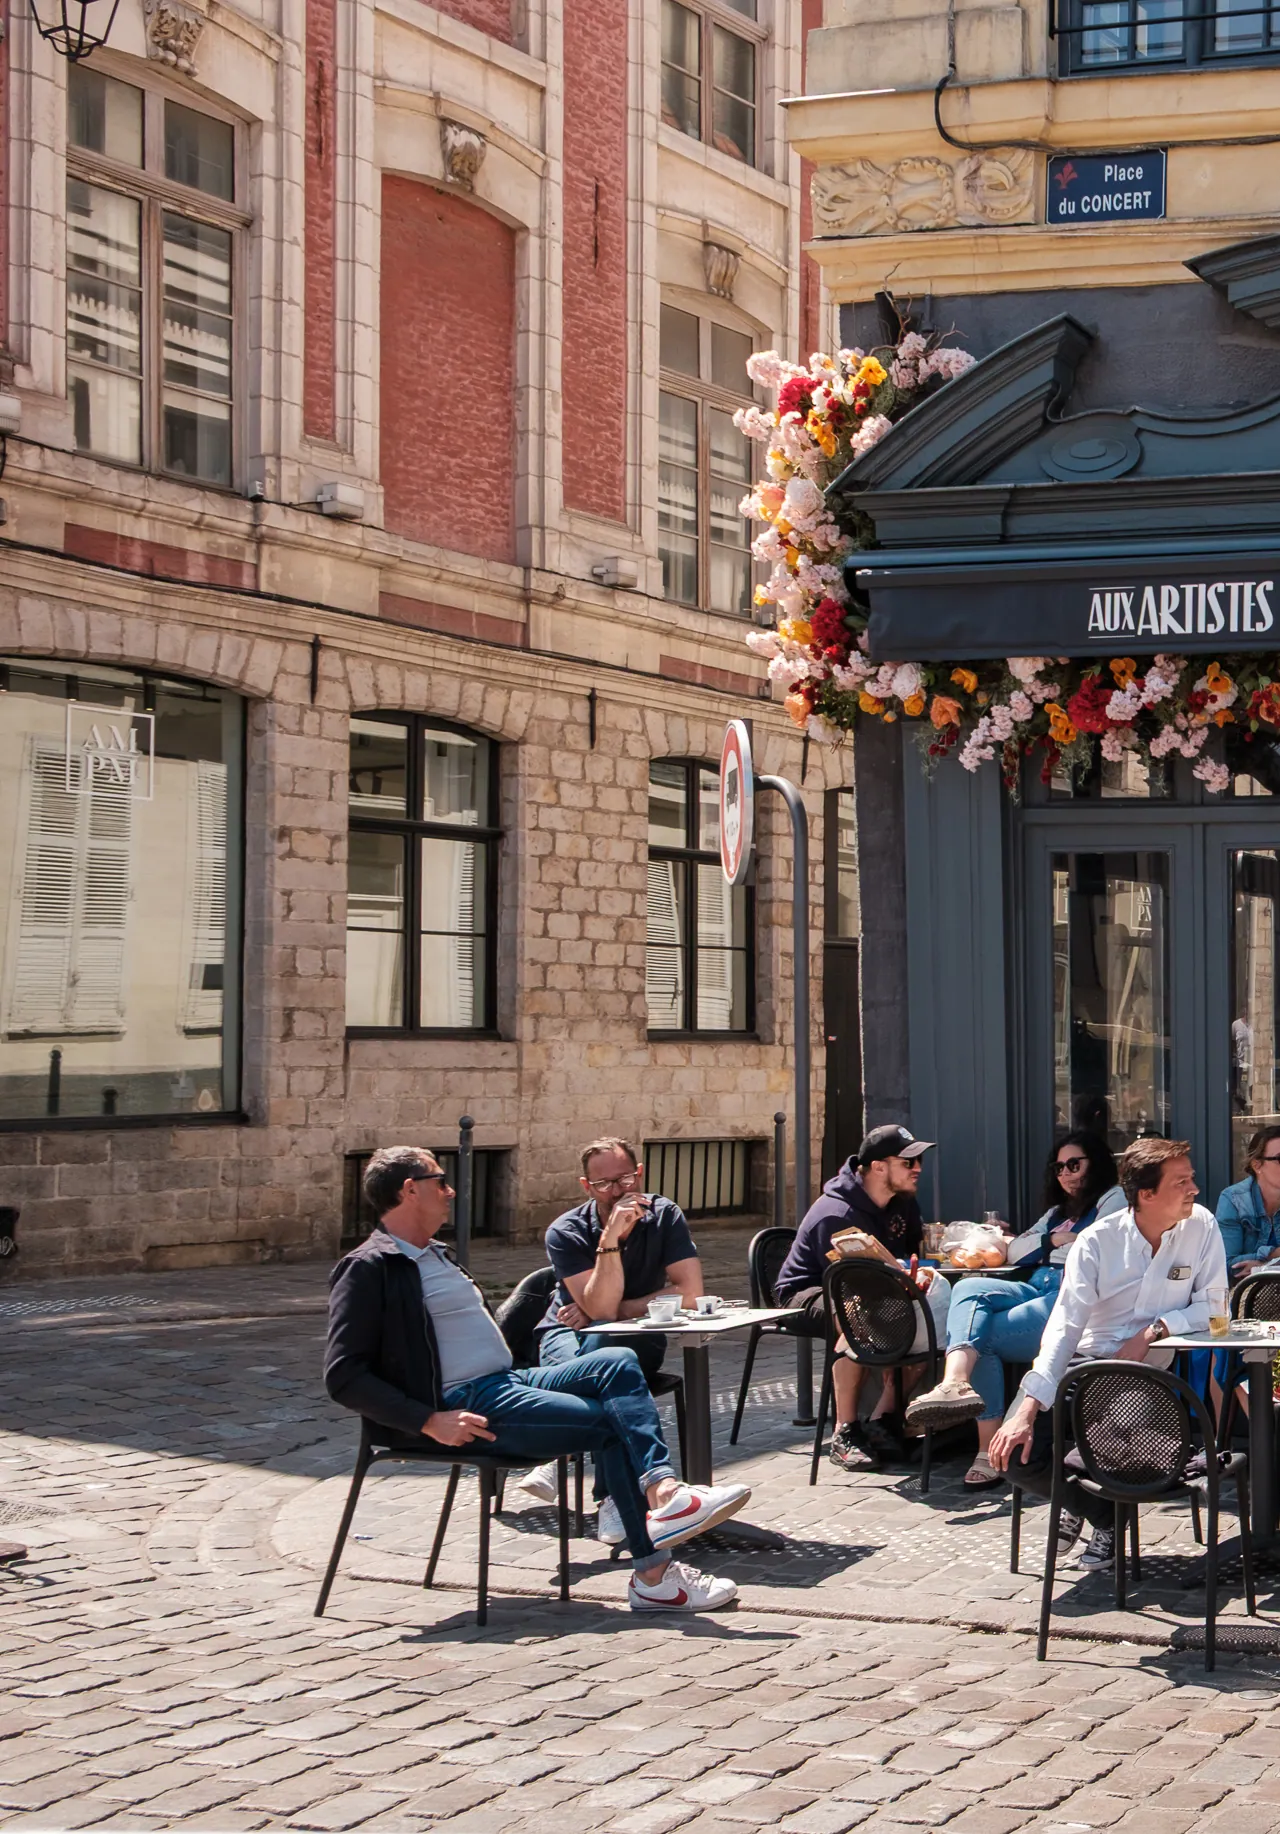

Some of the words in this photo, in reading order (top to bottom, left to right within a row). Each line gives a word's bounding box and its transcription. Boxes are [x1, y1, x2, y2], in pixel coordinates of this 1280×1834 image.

[1104, 165, 1144, 182] Place
[1058, 198, 1076, 215] du
[1081, 191, 1152, 213] CONCERT
[1087, 591, 1135, 632] AUX
[1137, 580, 1275, 635] ARTISTES
[83, 723, 139, 753] AM
[85, 755, 138, 784] PM
